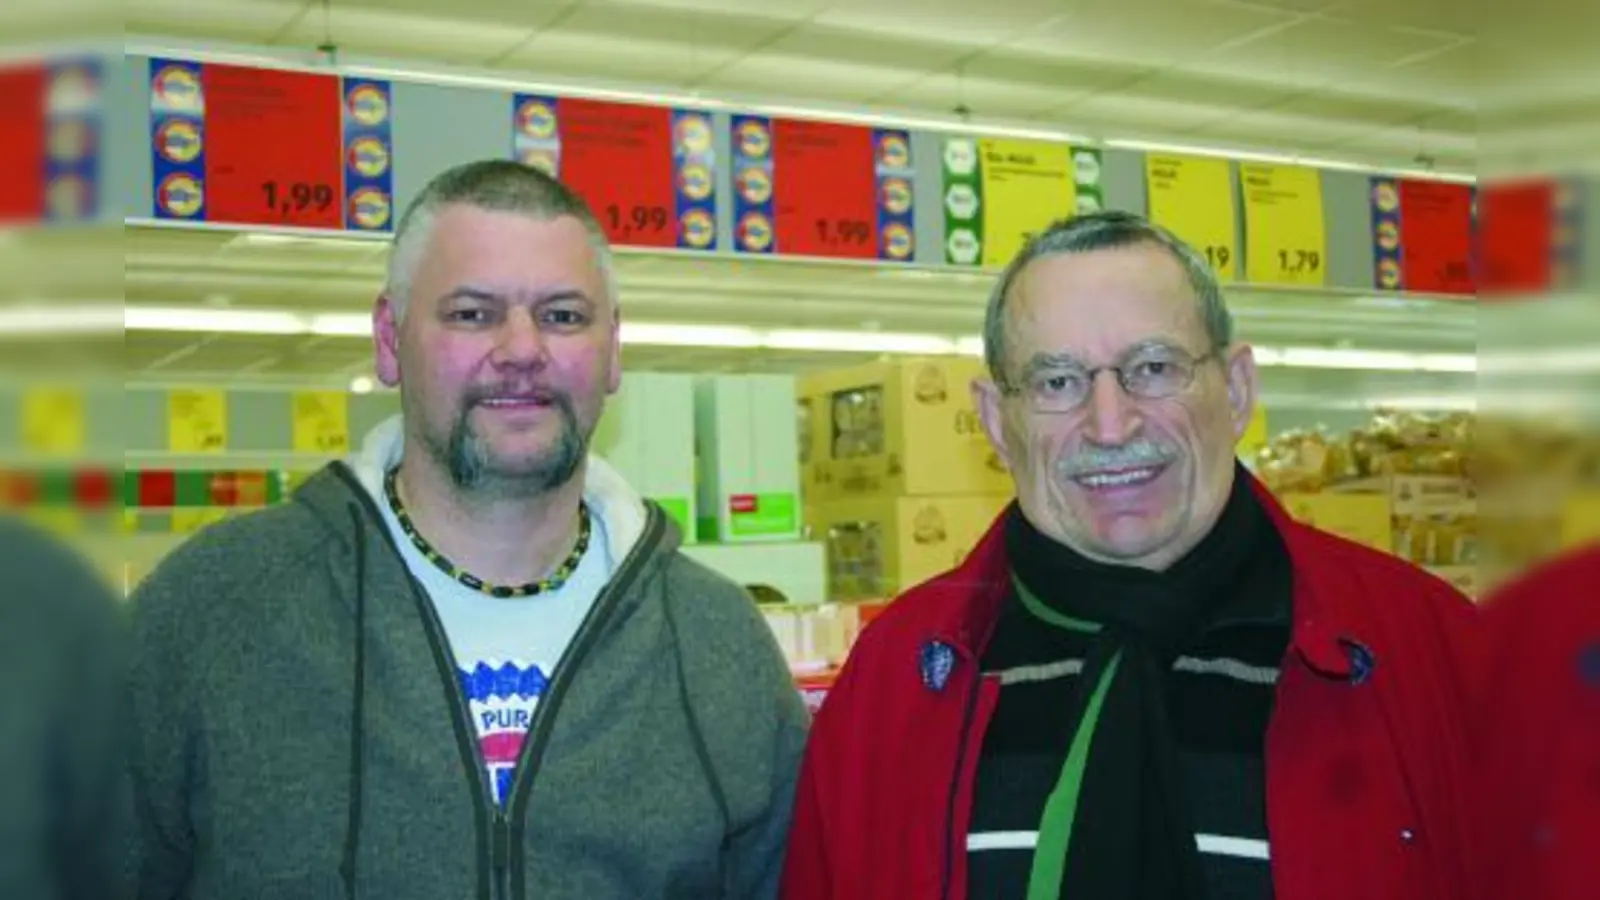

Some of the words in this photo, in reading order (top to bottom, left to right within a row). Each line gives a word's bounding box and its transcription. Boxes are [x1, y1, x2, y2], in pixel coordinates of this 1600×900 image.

[262, 180, 333, 214] 1,99
[607, 204, 668, 238] 1,99
[1278, 249, 1320, 273] 1,79
